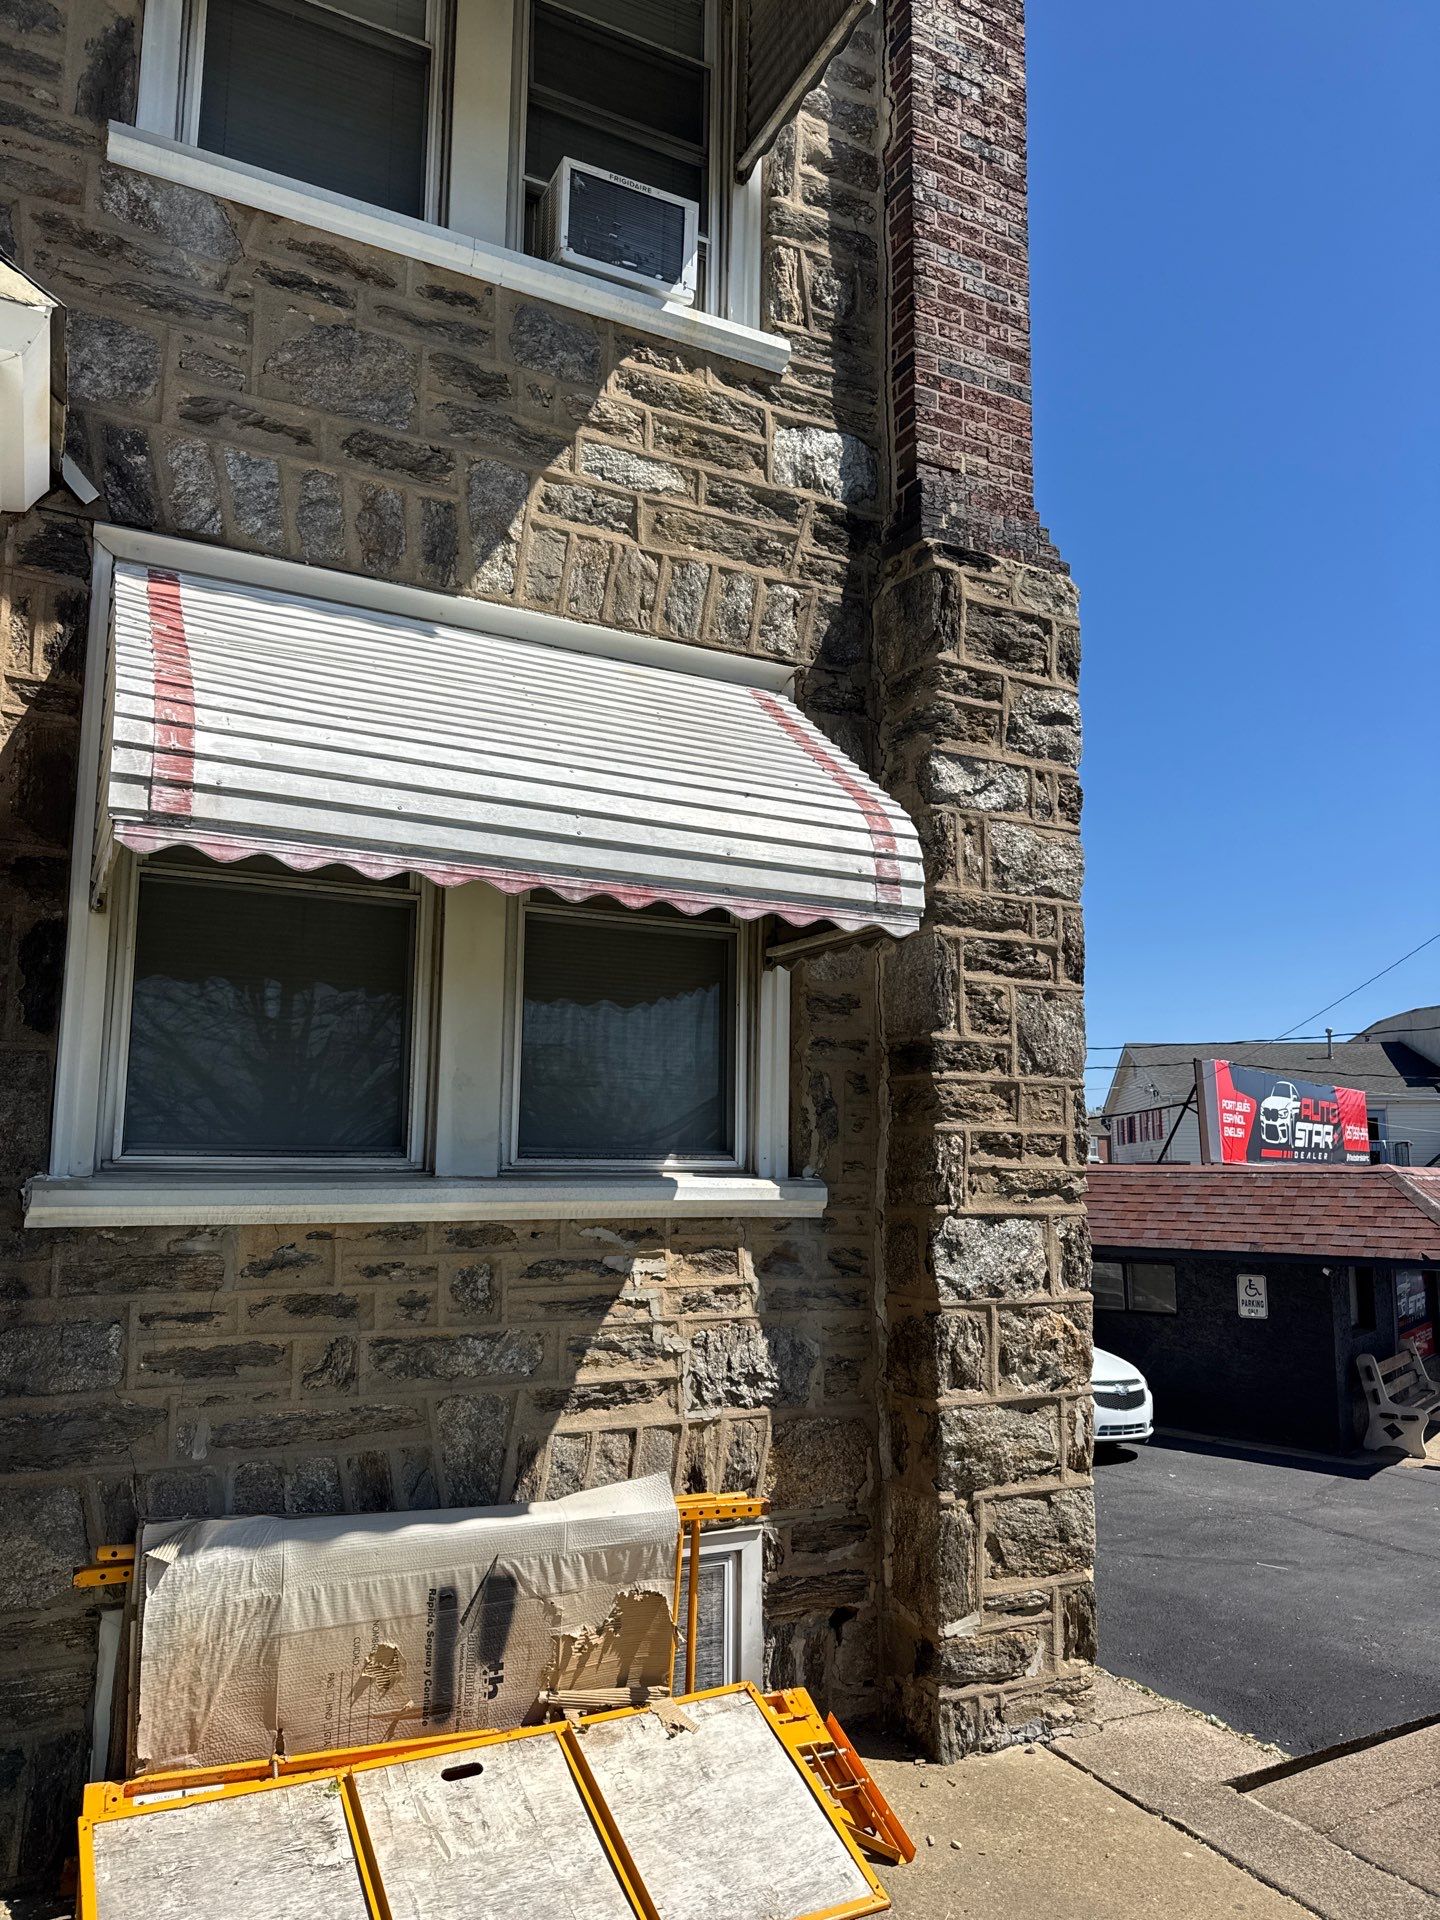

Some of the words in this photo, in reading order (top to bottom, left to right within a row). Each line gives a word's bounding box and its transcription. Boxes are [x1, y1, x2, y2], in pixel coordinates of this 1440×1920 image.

[609, 173, 652, 193] FRIGIDAIRE
[1223, 1112, 1246, 1125] ESPAÑOL
[1302, 1097, 1339, 1124] AUTO
[1224, 1127, 1245, 1138] ENGLISH
[1295, 1122, 1333, 1149] STAR
[1294, 1151, 1328, 1160] DEALER
[1241, 1299, 1264, 1308] PARKING
[426, 1588, 437, 1628] Rápido,
[425, 1630, 435, 1668] Seguro
[421, 1679, 433, 1727] Confiable
